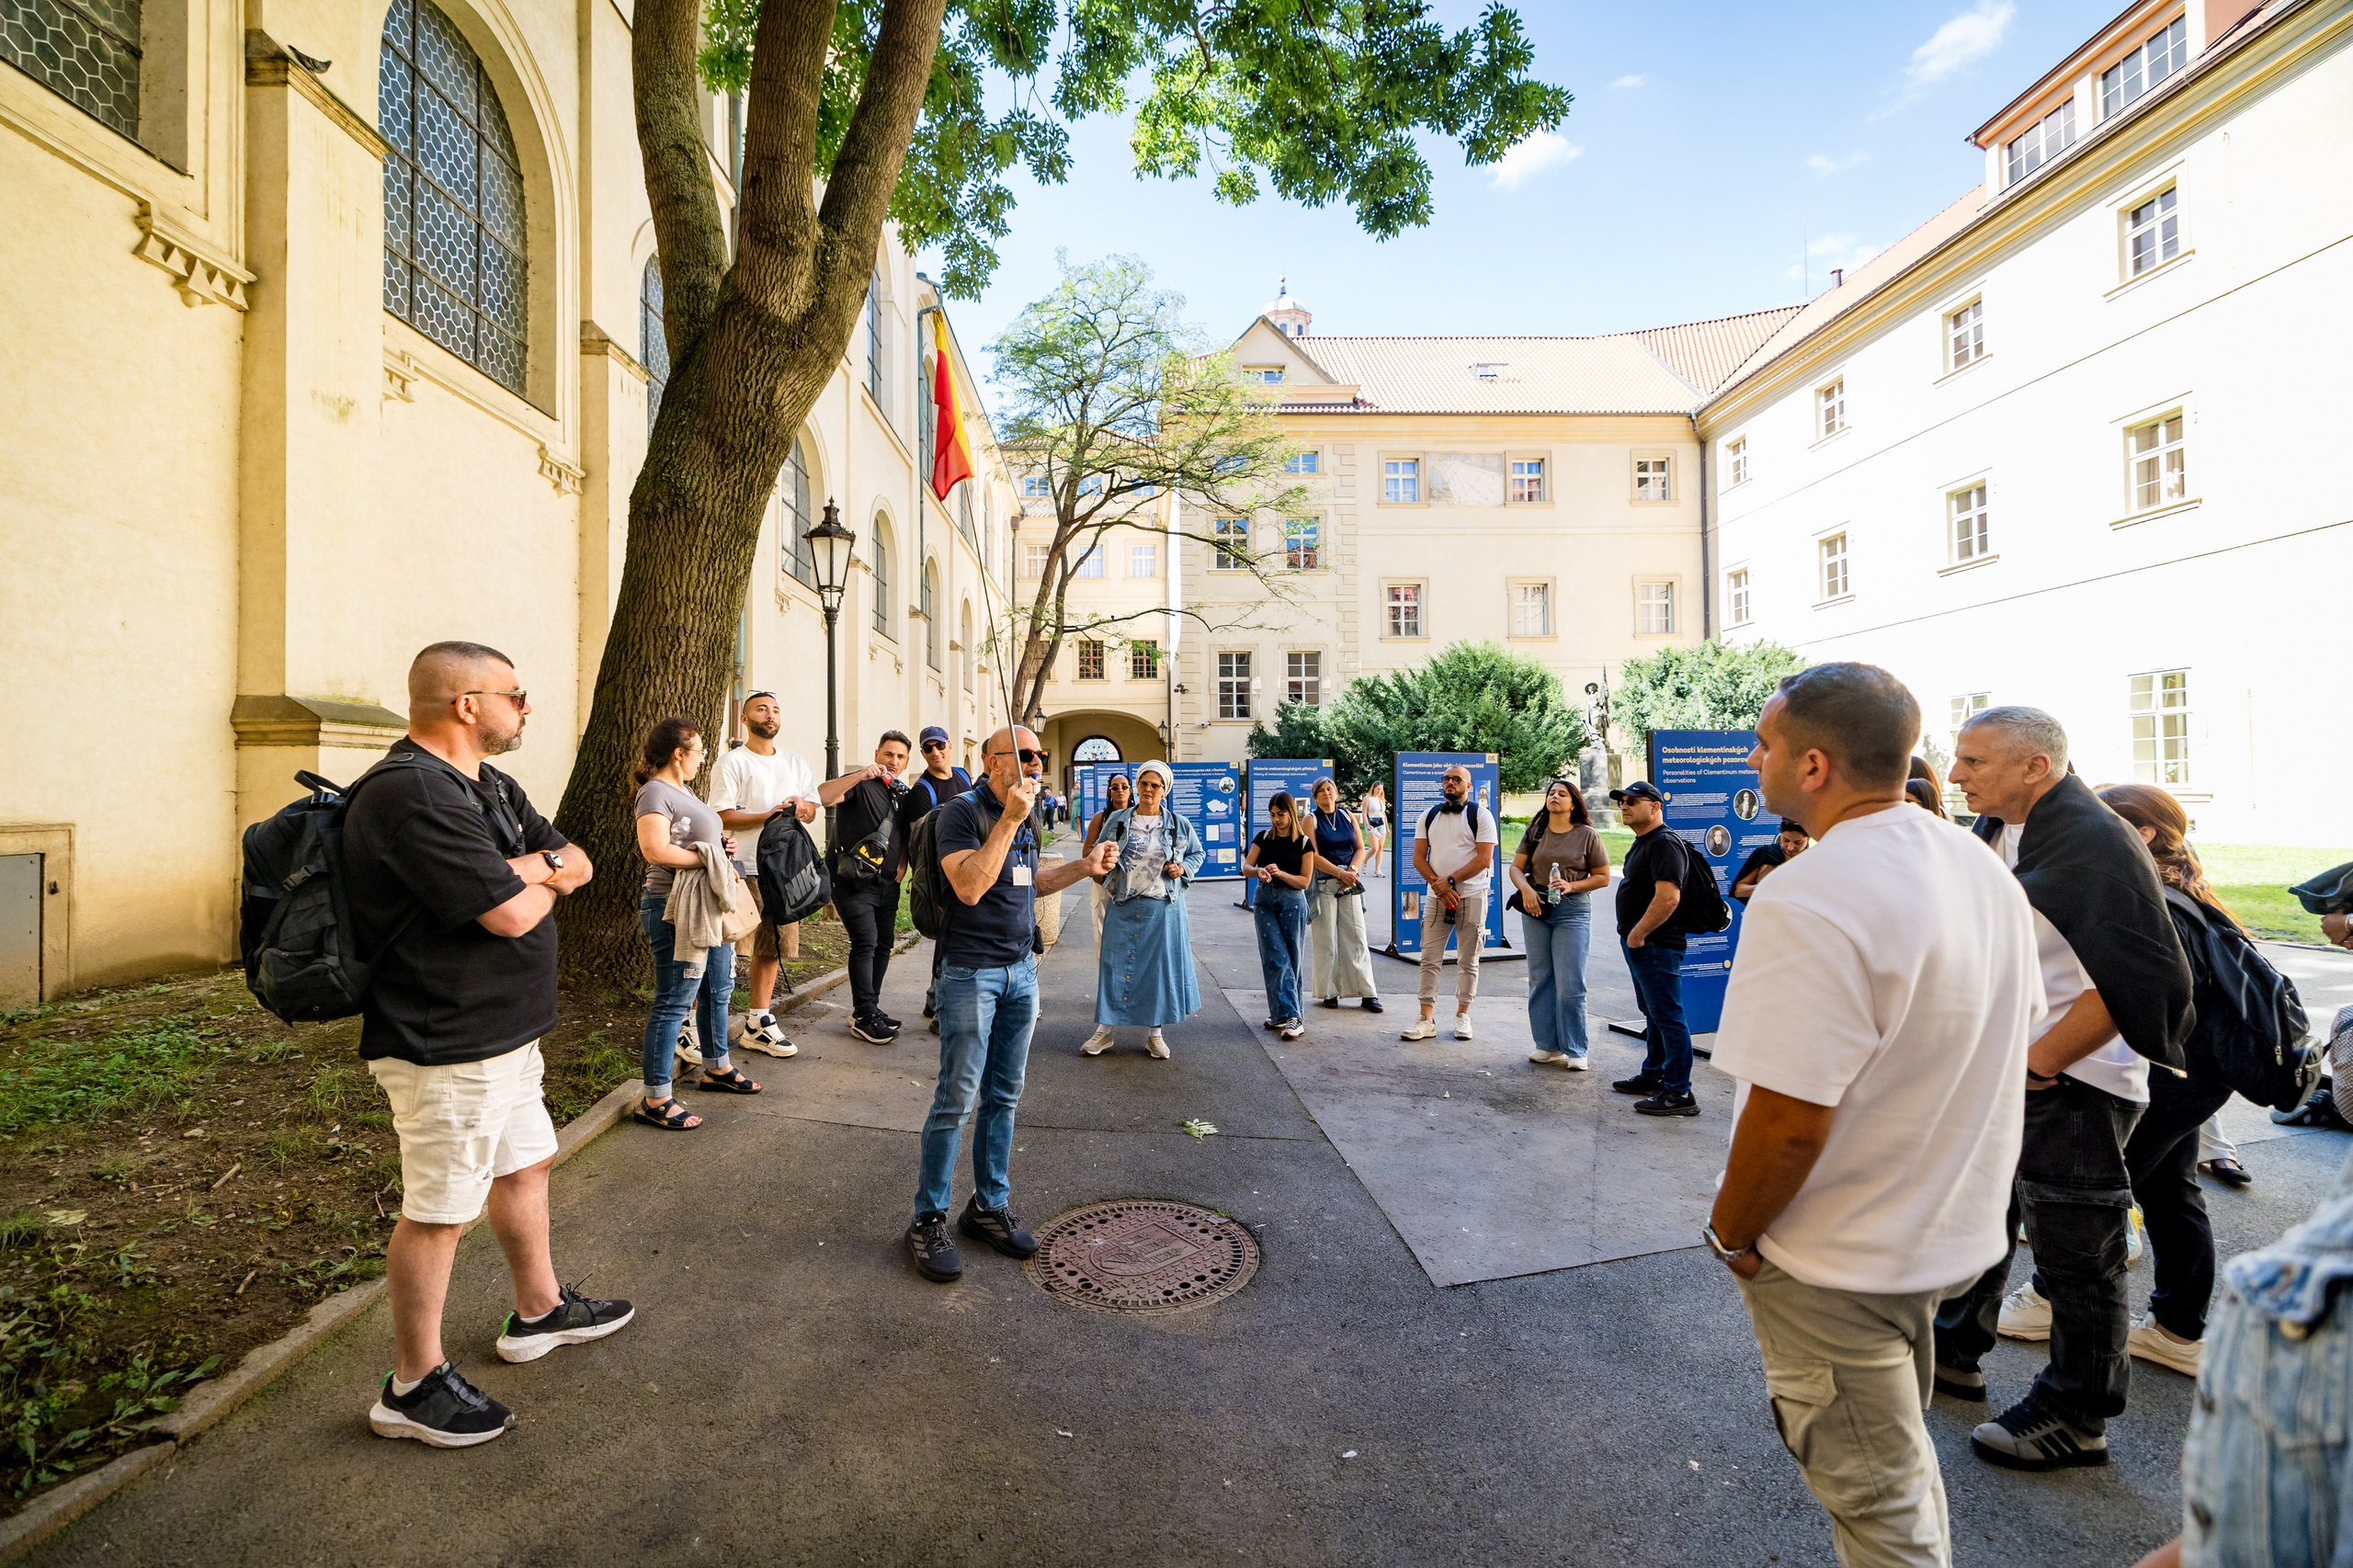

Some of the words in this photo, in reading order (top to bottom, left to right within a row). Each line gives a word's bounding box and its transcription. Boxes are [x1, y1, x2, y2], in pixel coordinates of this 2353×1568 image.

[1697, 746, 1749, 755] klementinských
[1662, 756, 1722, 765] meteorologických
[1722, 756, 1748, 765] pozorov
